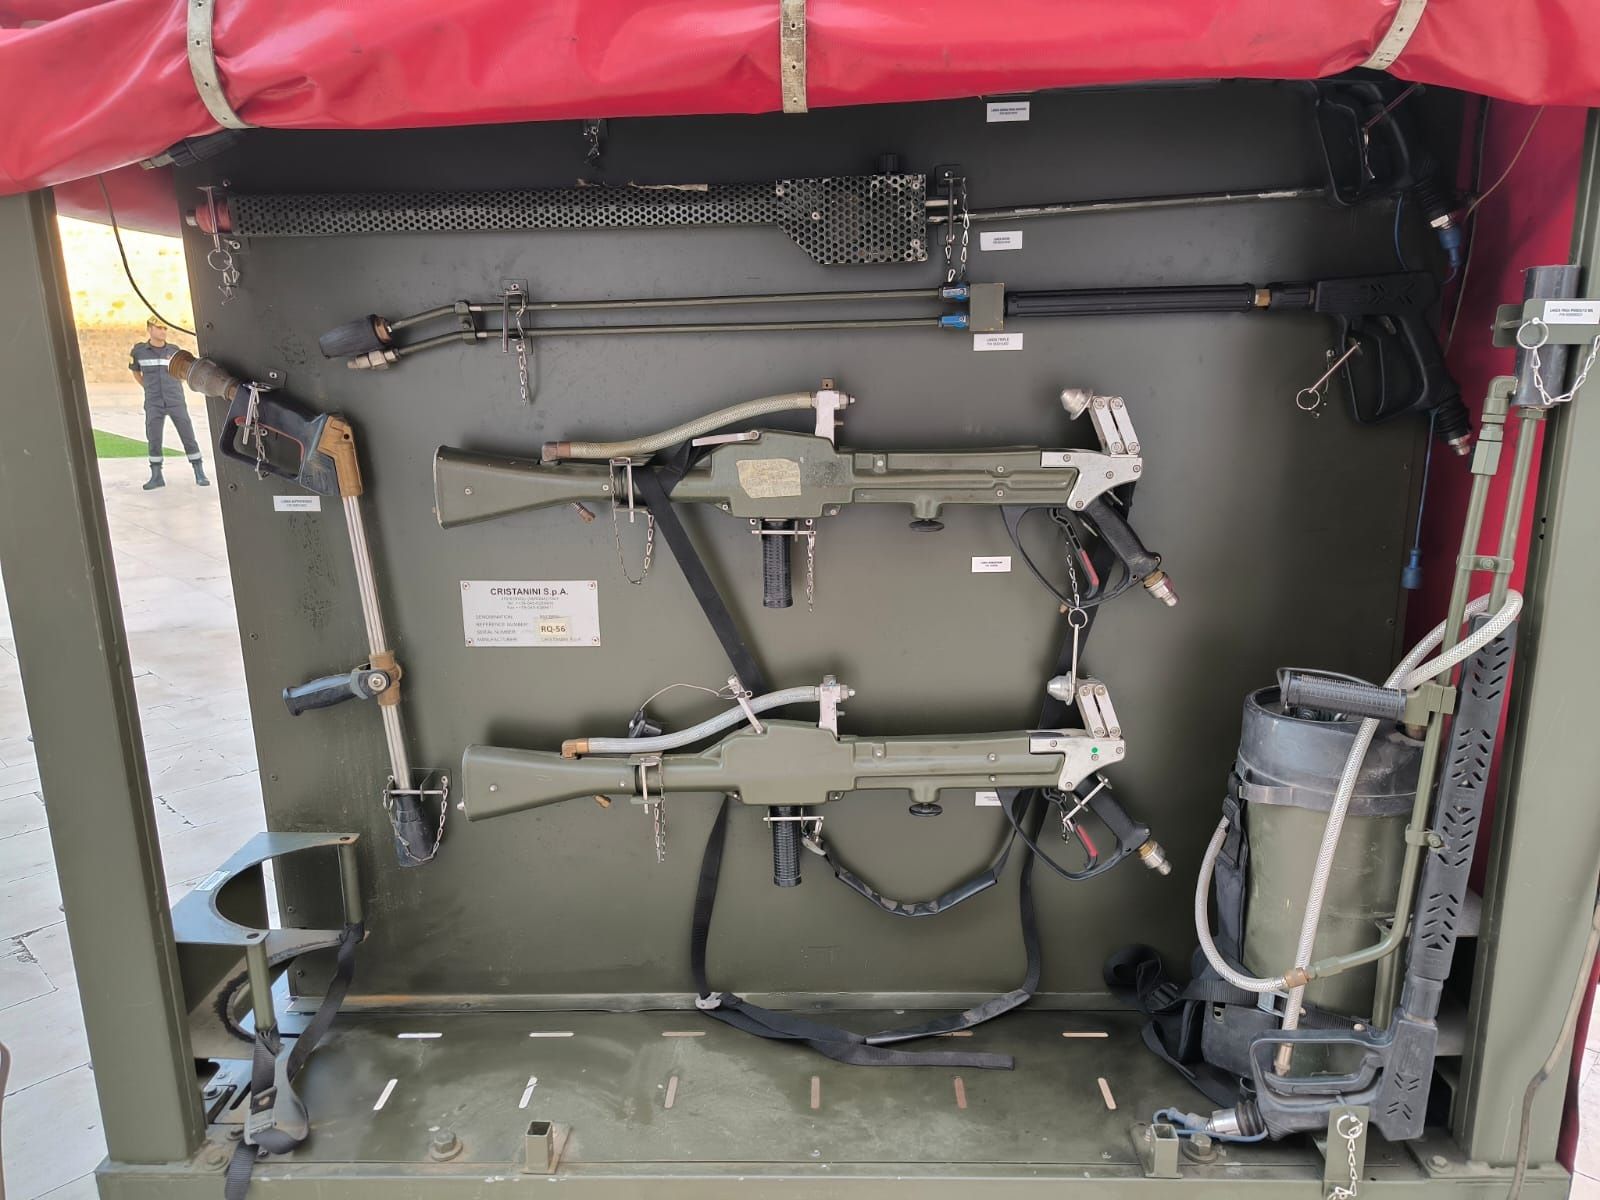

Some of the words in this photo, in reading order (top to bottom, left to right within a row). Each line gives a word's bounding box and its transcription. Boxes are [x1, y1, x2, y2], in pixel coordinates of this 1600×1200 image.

[490, 588, 541, 596] CRISTANINI
[543, 588, 569, 597] S.p.A.
[540, 625, 566, 633] RQ-56
